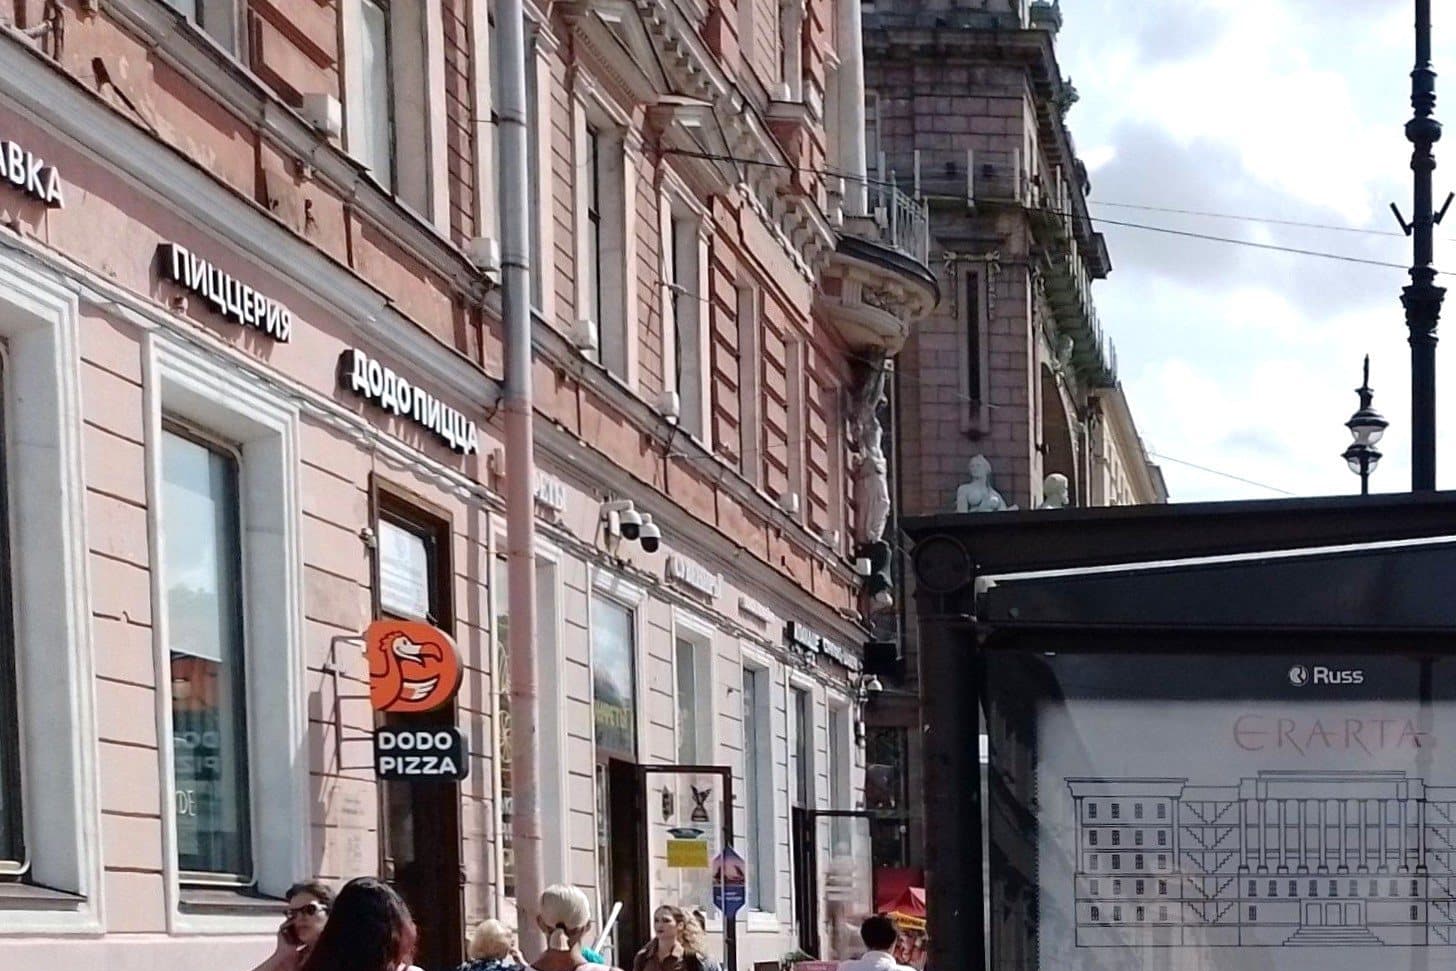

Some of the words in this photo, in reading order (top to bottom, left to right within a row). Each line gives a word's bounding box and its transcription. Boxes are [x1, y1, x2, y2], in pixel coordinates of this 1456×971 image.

[172, 242, 292, 344] ПИЦЦЕРИЯ
[352, 348, 412, 416] ДОДО
[413, 386, 480, 455] ПИЦЦА
[1313, 666, 1364, 684] Russ
[378, 731, 453, 751] DODO
[1233, 713, 1430, 756] ERARTA
[379, 756, 458, 775] PIZZA
